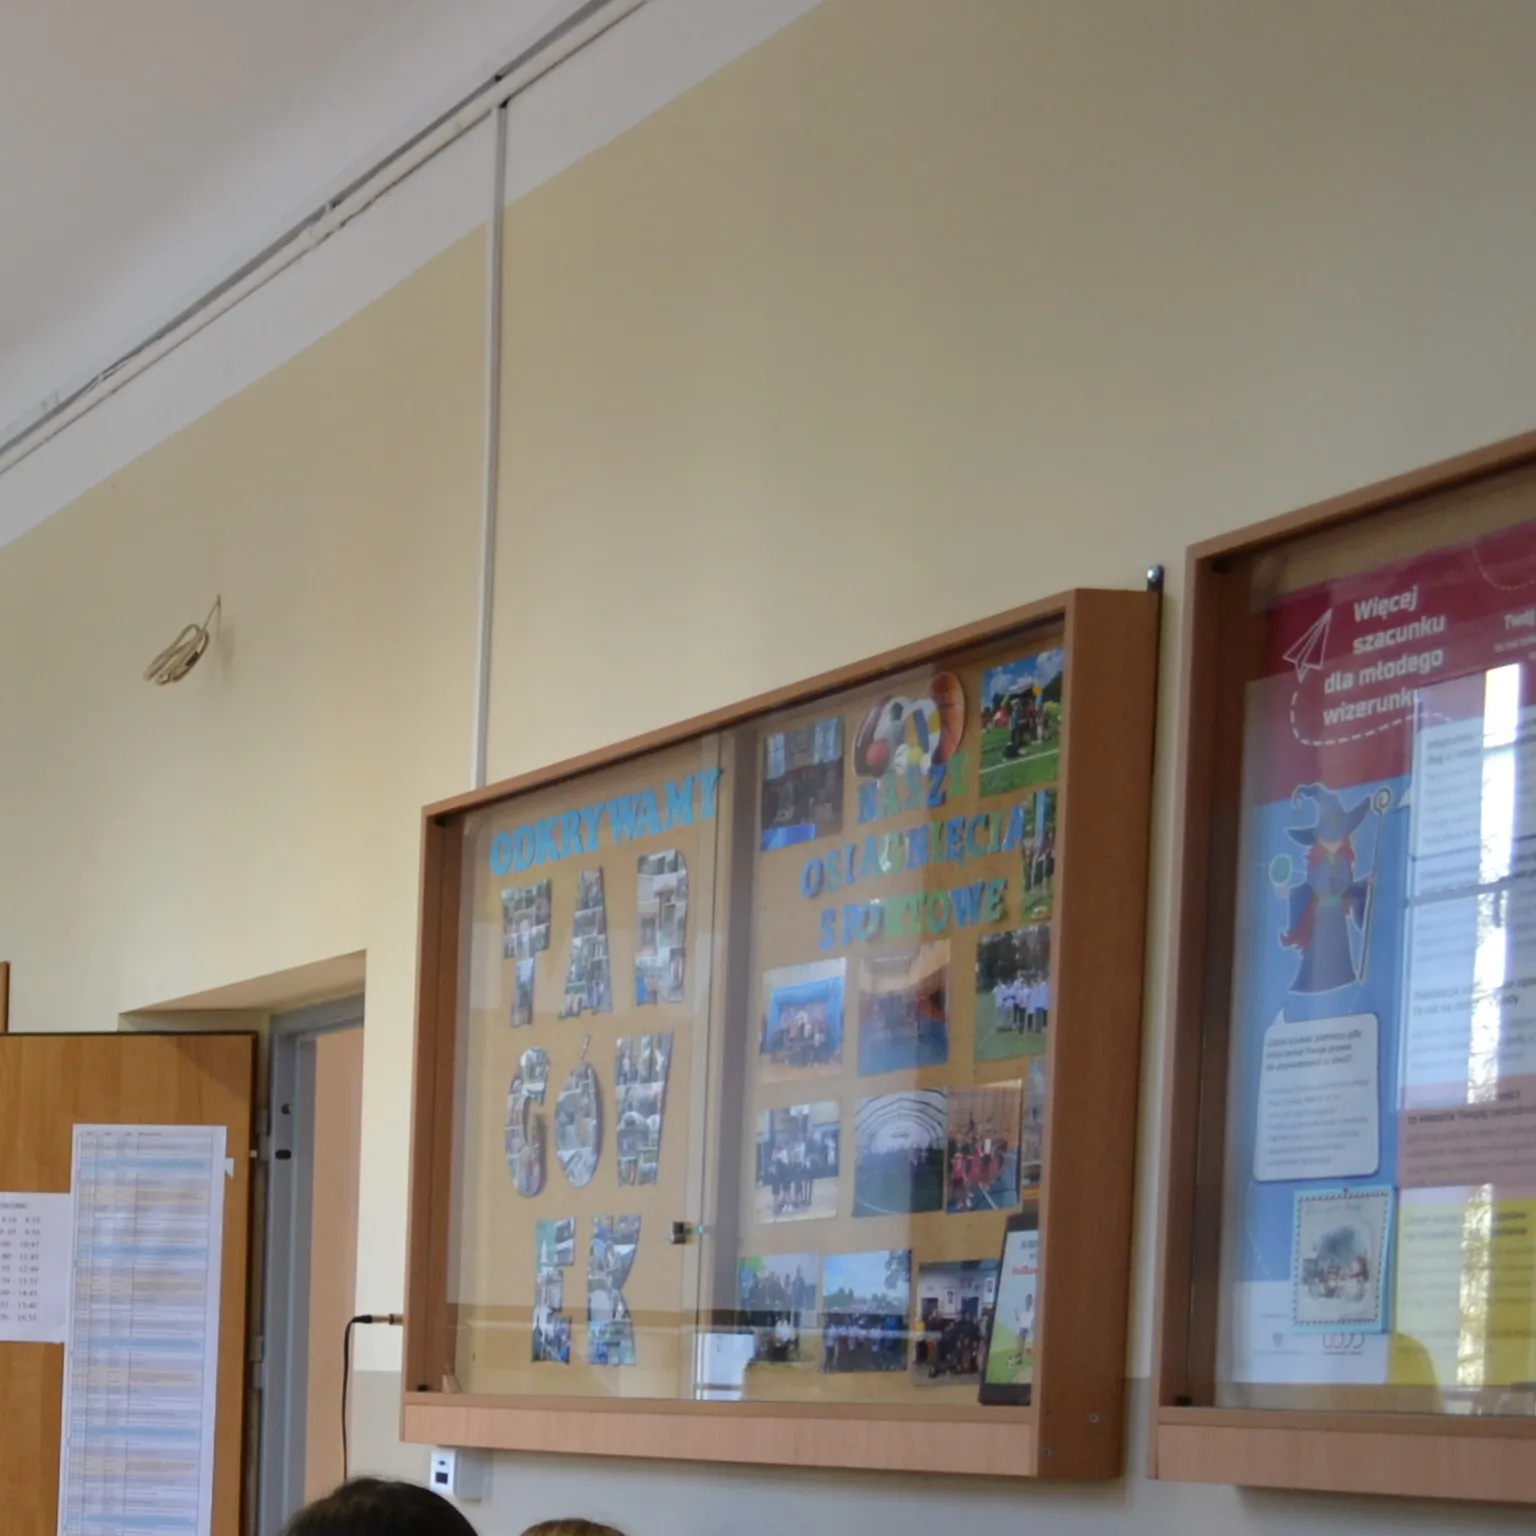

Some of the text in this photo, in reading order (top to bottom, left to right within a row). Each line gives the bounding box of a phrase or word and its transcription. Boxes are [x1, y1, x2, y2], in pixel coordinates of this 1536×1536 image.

[1353, 585, 1419, 623] Więcej
[1352, 615, 1446, 655] szacunku
[1324, 649, 1444, 695] dla młodego
[1322, 686, 1418, 726] wizerunk
[857, 751, 969, 824] NASZE
[489, 767, 724, 877] ODKRYWAMY
[819, 878, 1007, 949] SPORTOWE
